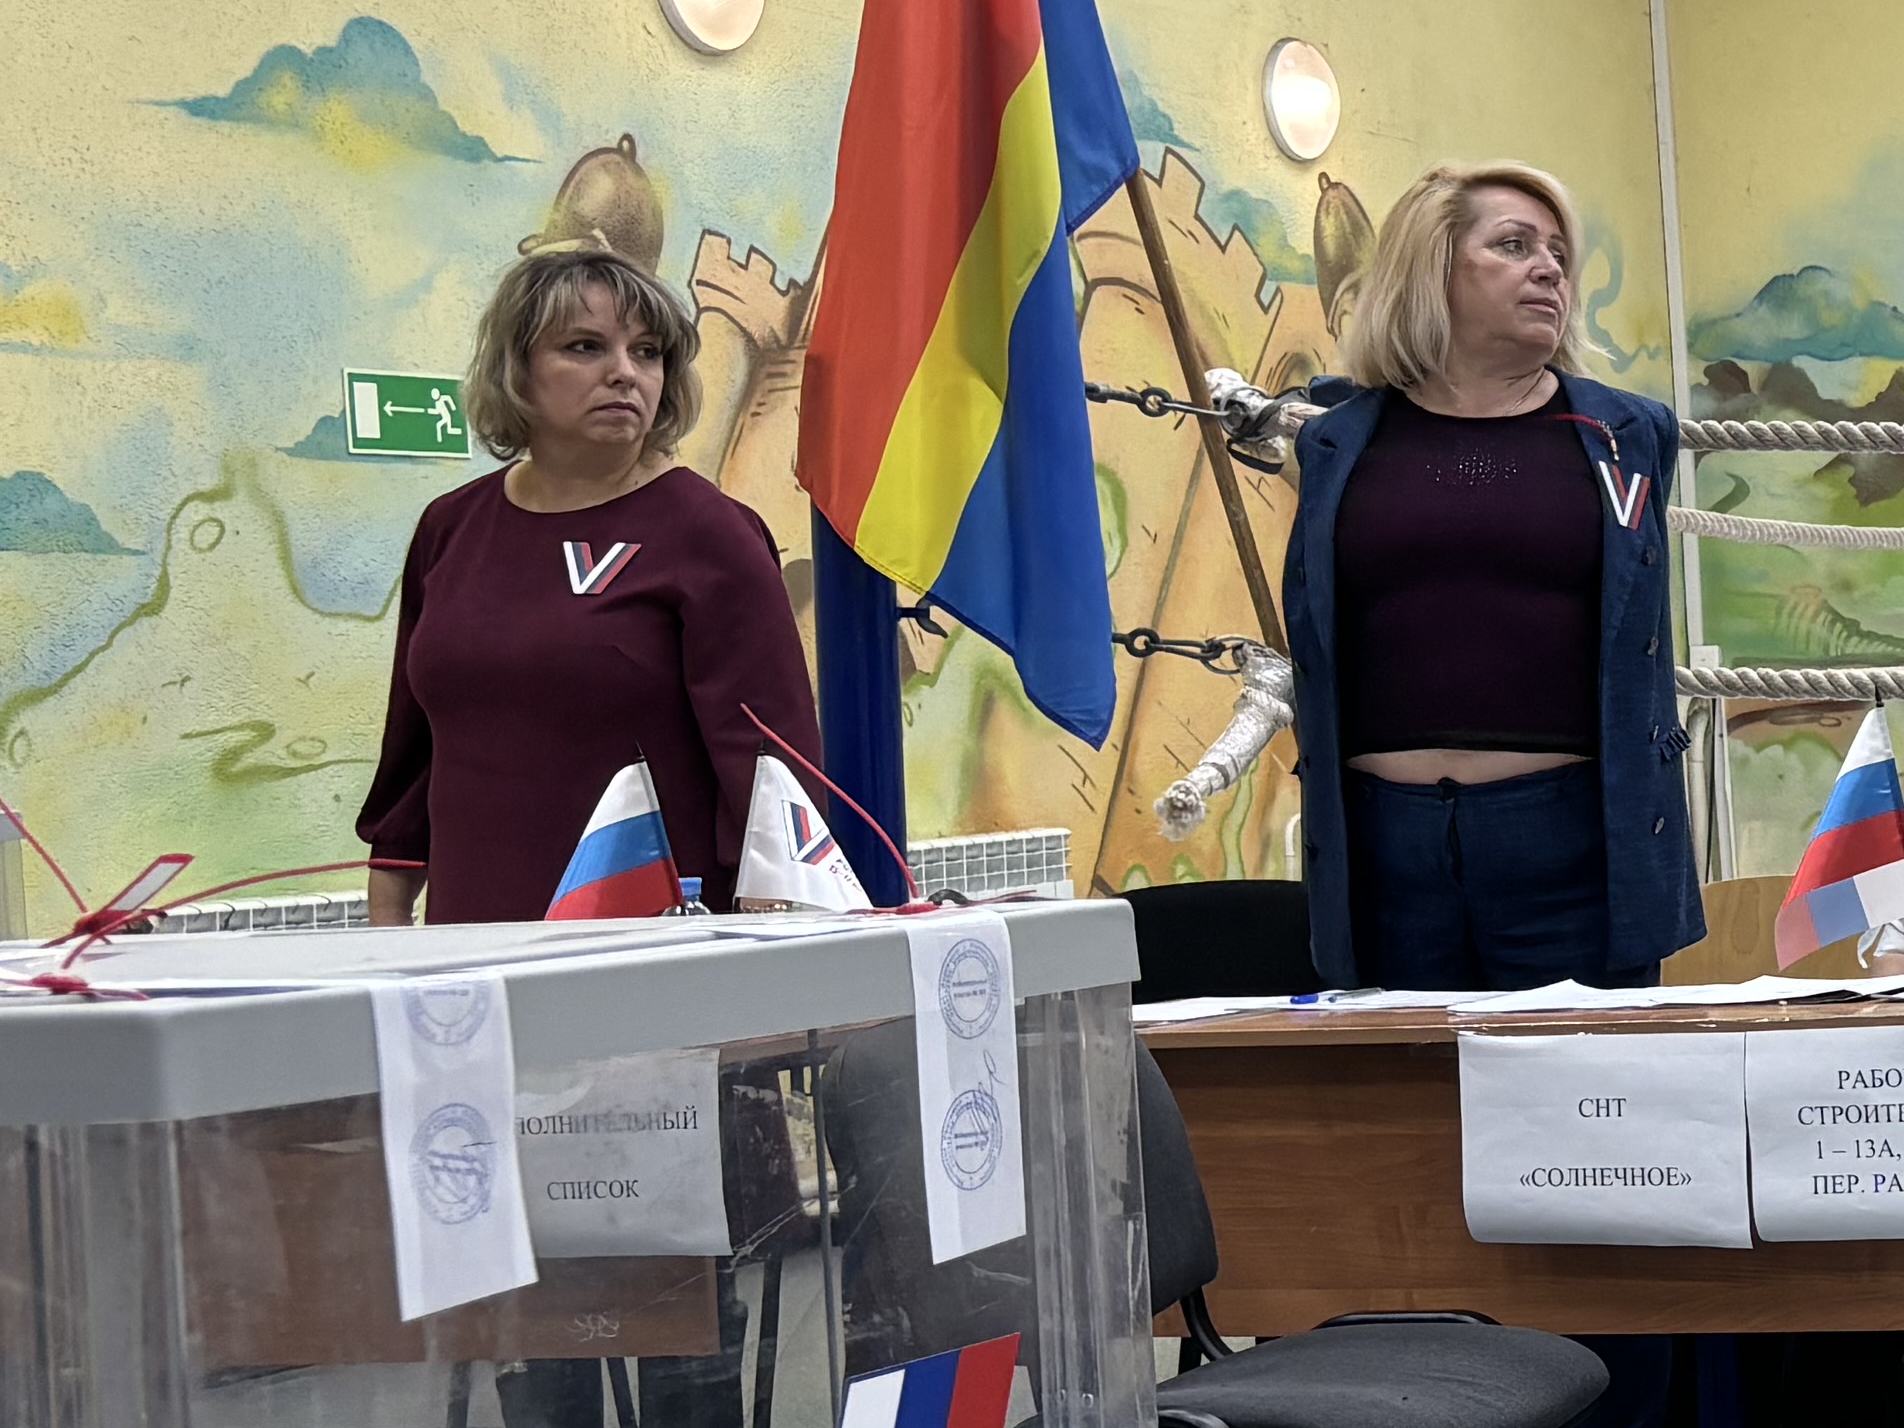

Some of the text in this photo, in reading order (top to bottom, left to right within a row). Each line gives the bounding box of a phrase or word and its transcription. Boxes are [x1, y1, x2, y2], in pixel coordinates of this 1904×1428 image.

[1578, 1097, 1627, 1118] СНТ
[1855, 1138, 1902, 1161] 13А,
[1519, 1166, 1692, 1188] «СОЛНЕЧНОЕ»
[1812, 1174, 1867, 1195] ПЕР.
[546, 1179, 639, 1201] СПИСОК
